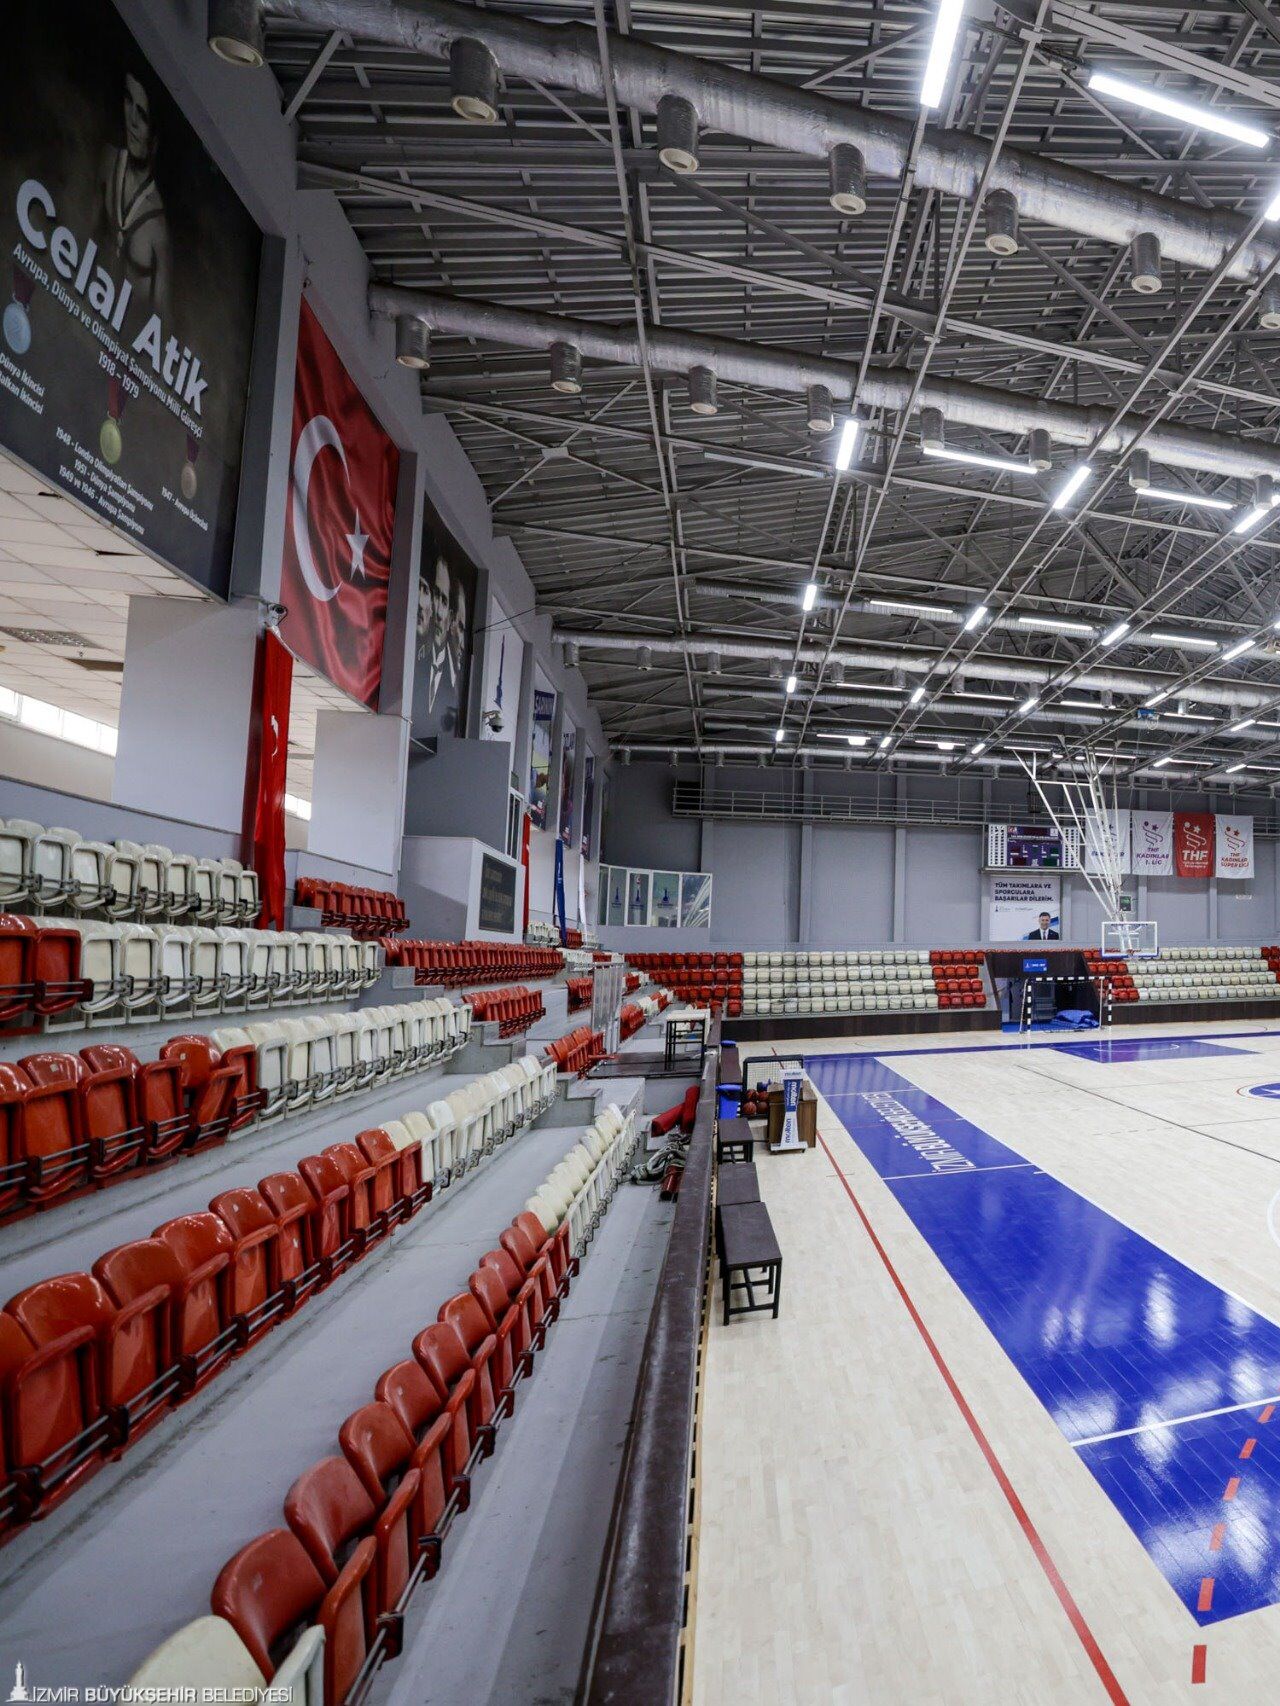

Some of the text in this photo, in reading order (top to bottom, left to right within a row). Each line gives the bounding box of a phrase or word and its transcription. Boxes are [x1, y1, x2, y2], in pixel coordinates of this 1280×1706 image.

[13, 243, 50, 291] Avrupa,
[51, 280, 81, 317] Dünya
[80, 311, 92, 328] ve
[91, 320, 130, 367] Olimpiyat
[17, 179, 209, 415] Celal Atik
[0, 370, 20, 397] alkan
[98, 350, 117, 377] 1918
[121, 374, 140, 399] 1979
[1182, 850, 1209, 861] THF
